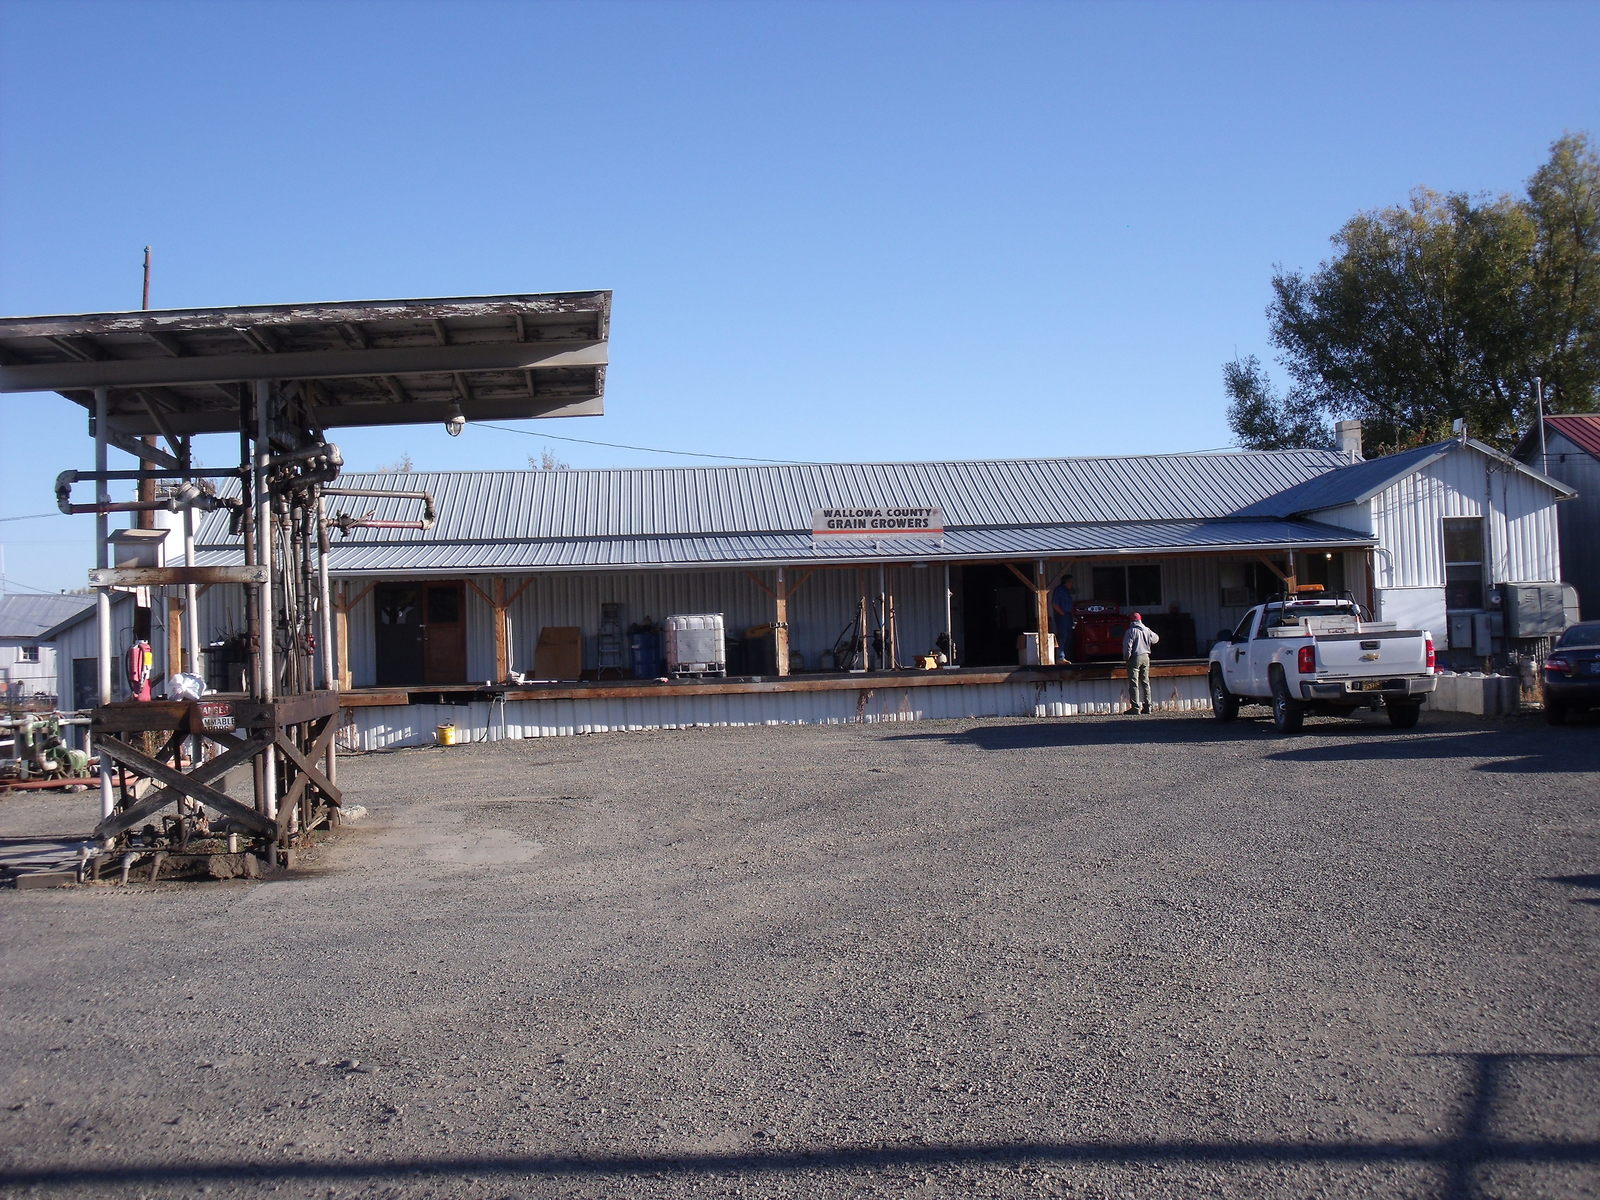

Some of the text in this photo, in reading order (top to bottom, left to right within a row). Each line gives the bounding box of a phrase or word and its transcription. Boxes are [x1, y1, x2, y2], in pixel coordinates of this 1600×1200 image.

[823, 508, 932, 518] WALLOWA COUNTY
[827, 518, 929, 529] GRAIN GROWERS
